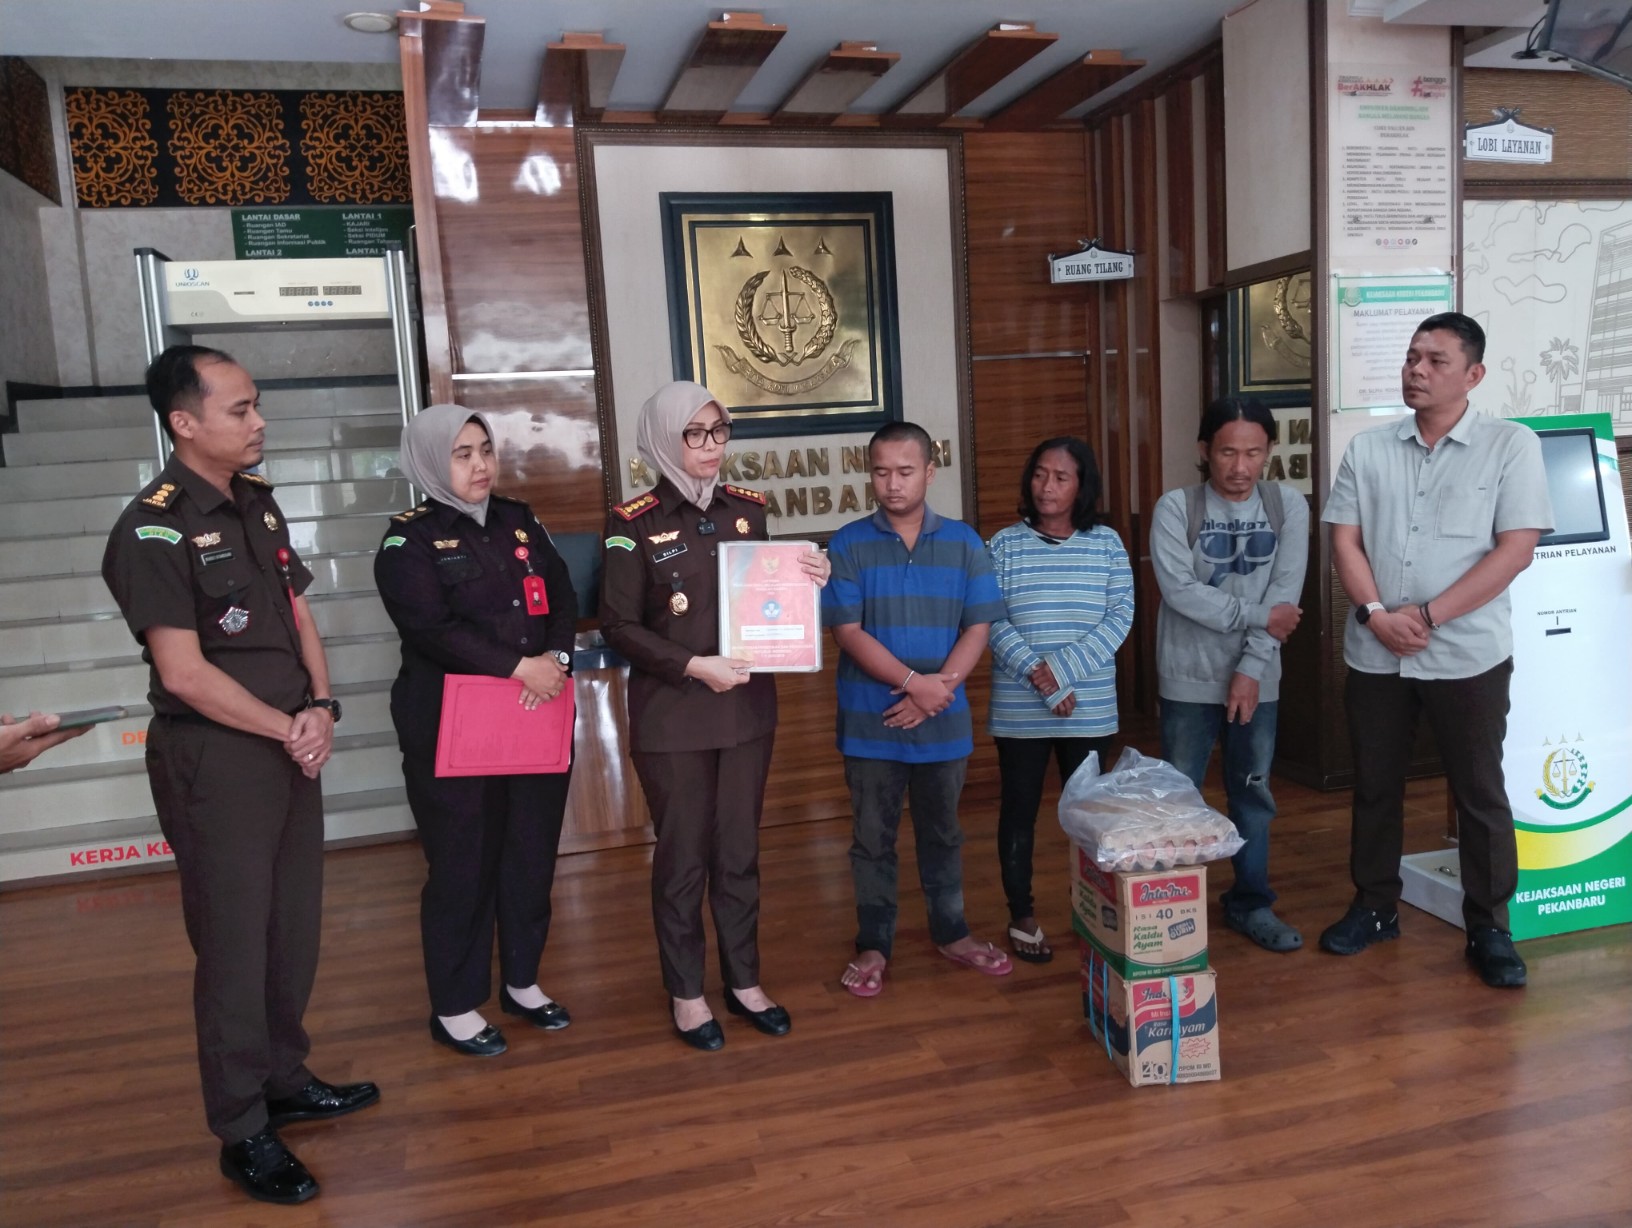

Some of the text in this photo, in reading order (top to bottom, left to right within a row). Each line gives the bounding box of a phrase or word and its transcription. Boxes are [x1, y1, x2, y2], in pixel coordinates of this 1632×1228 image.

[1477, 137, 1542, 154] LOBI LAYANAN
[273, 213, 301, 221] DASAR
[1065, 262, 1123, 276] RUANG TILANG
[1353, 308, 1435, 318] MAKLUMAT PELAYANAN
[629, 447, 831, 488] KKSAAN
[1534, 545, 1617, 560] TRIAN PELAYANAN
[122, 731, 147, 745] DE
[70, 841, 175, 867] KERJA KE
[1515, 876, 1626, 903] KEJAKSAAN NEGERI
[1538, 894, 1606, 915] PEKANBARU
[1156, 908, 1174, 920] 40
[1180, 907, 1197, 915] BKS
[1133, 931, 1163, 941] Kaldu
[1133, 940, 1163, 950] Ayam
